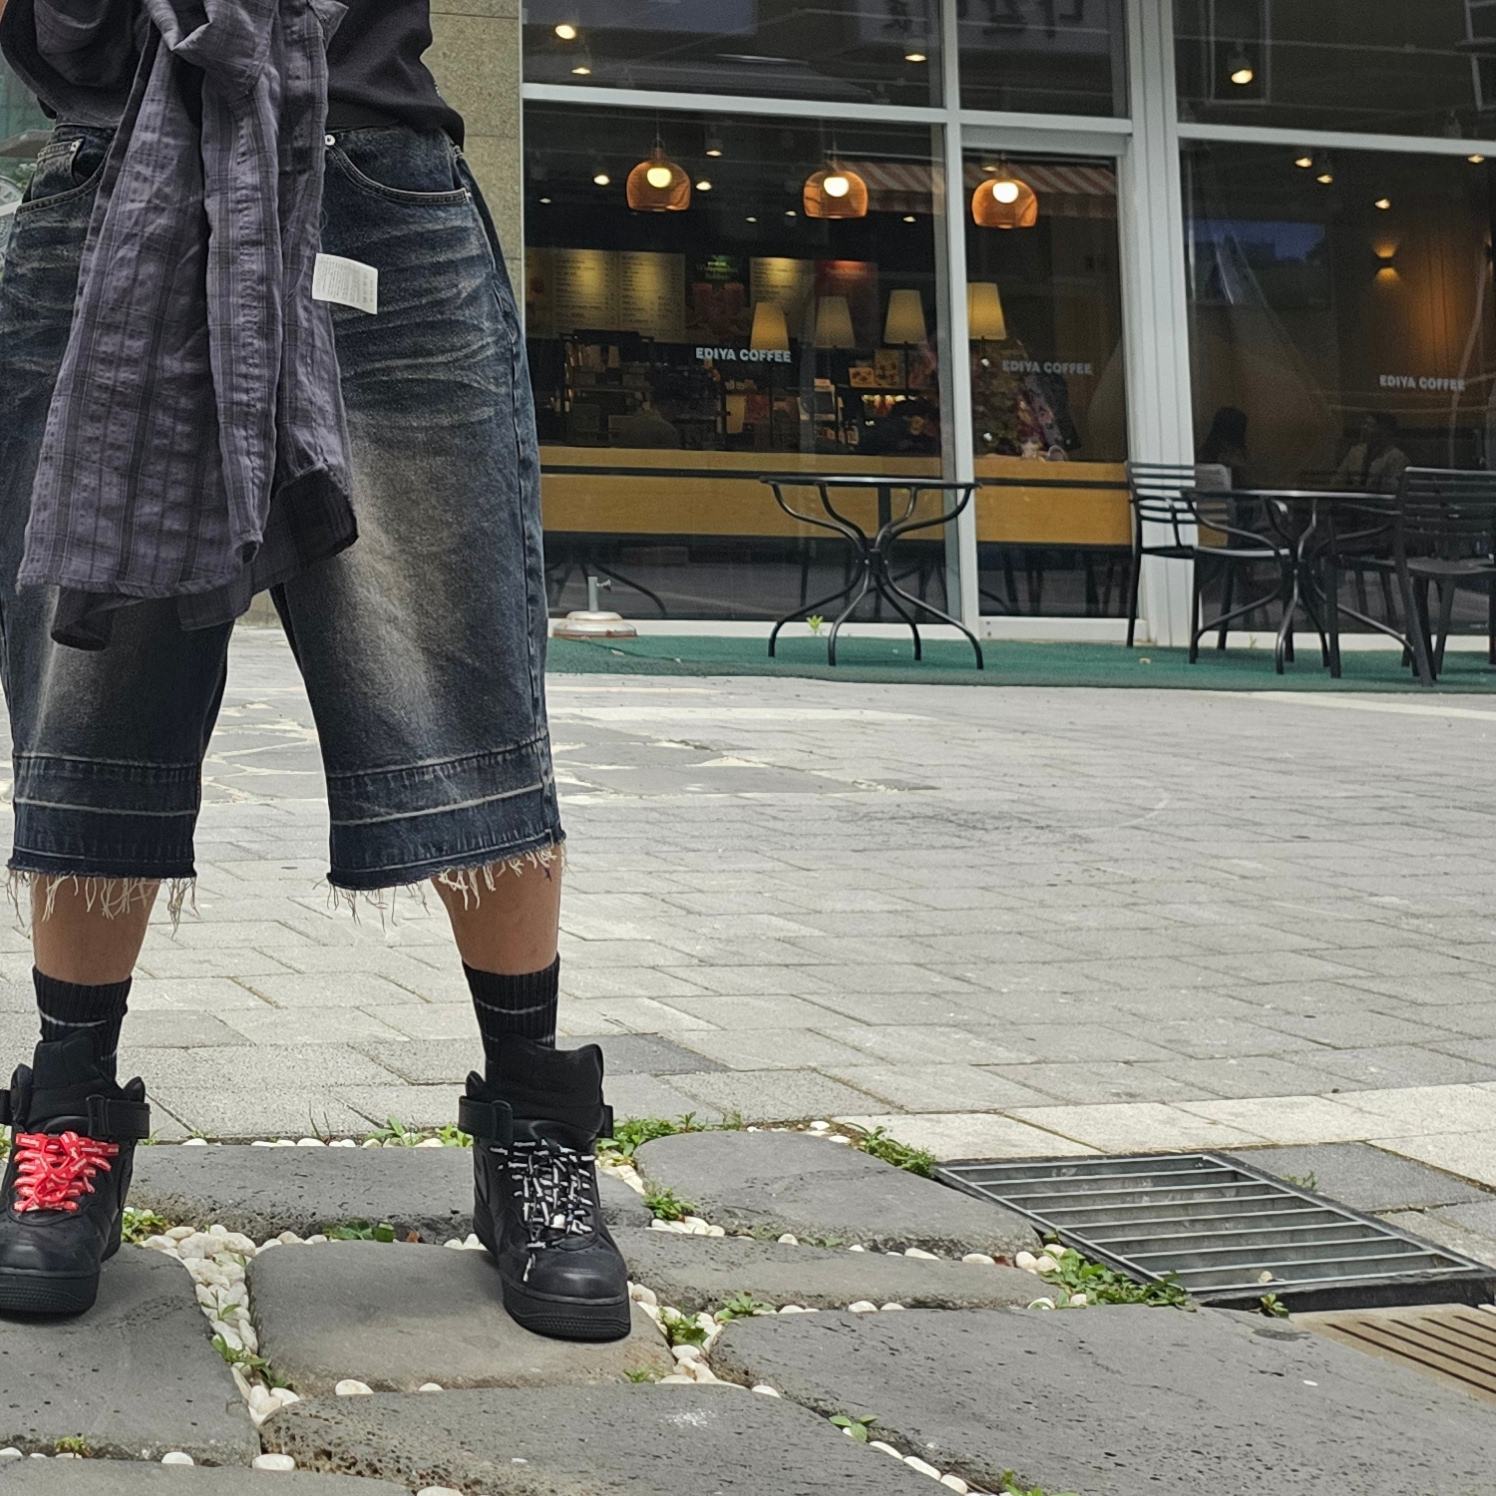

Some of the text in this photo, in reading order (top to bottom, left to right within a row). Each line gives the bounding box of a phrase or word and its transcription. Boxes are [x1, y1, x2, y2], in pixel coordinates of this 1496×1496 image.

[695, 347, 792, 363] EDIYA COFFEE
[1002, 359, 1093, 375] EDIYA COFFEE
[1379, 374, 1465, 392] EDIYA COFFEE
